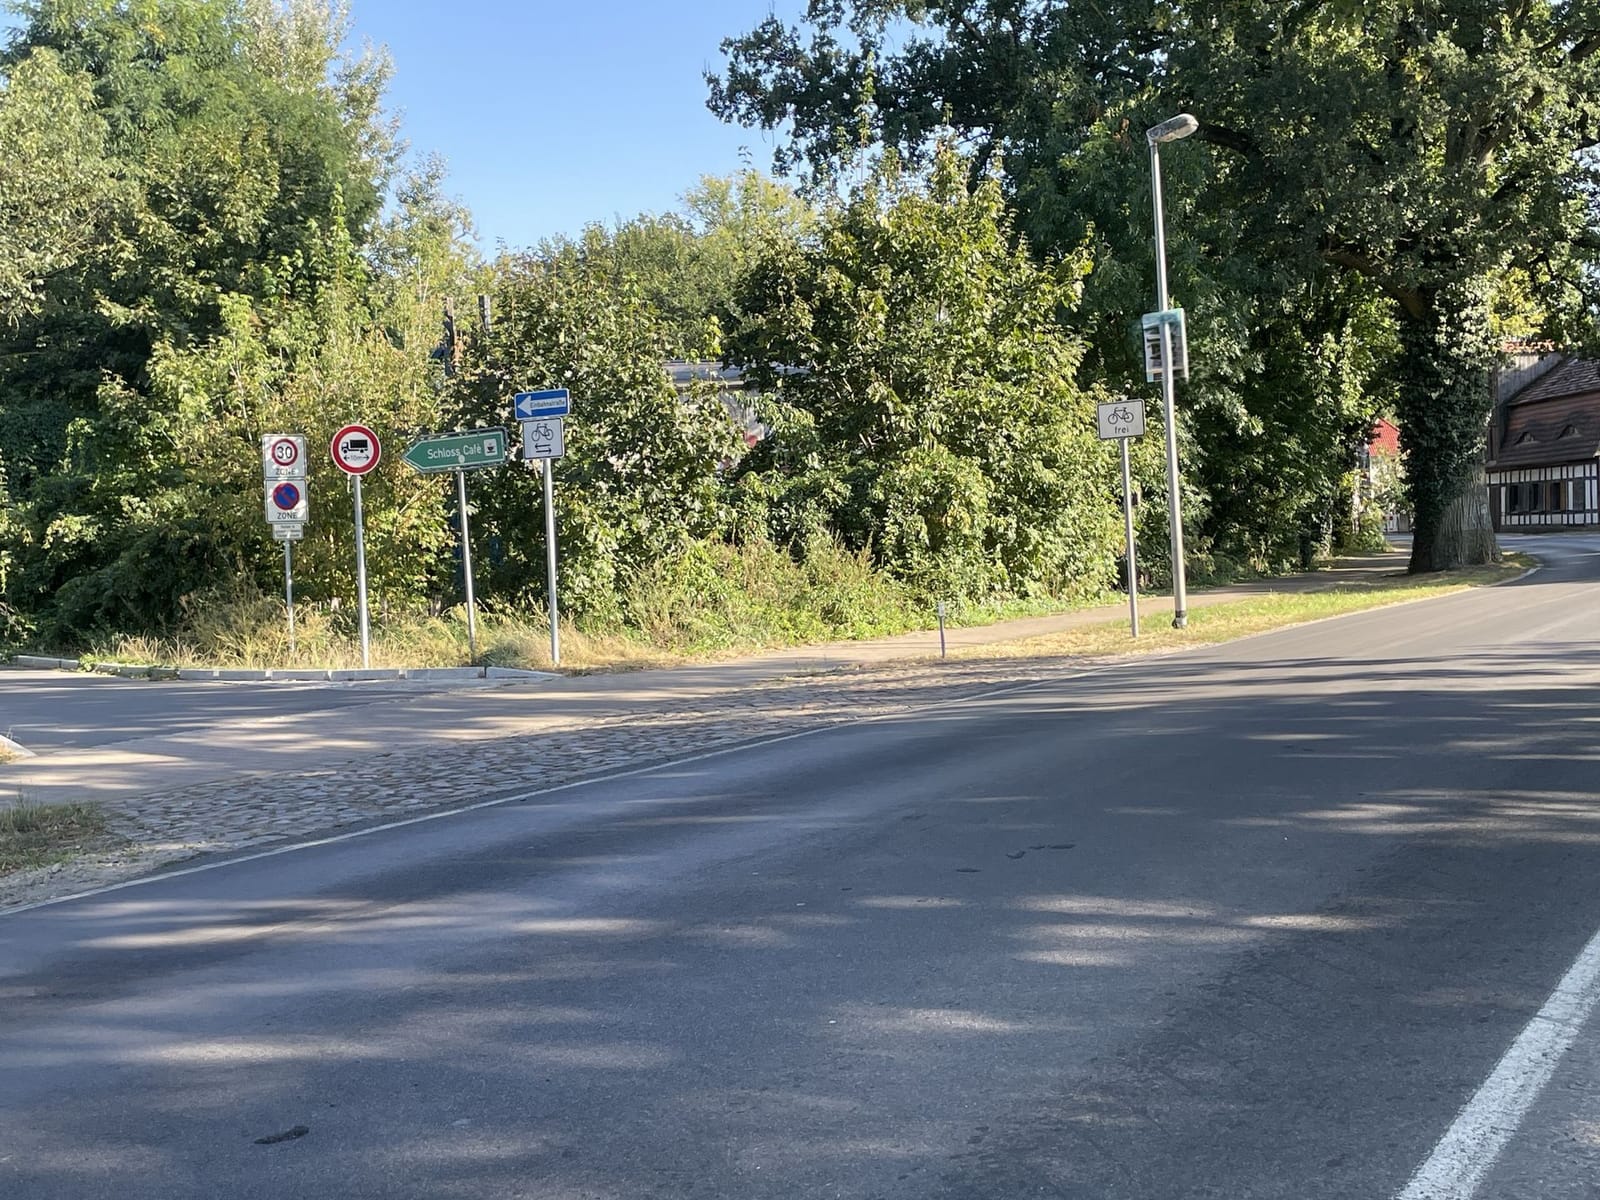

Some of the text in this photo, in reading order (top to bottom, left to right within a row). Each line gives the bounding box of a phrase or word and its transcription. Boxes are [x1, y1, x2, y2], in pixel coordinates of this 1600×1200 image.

[1114, 426, 1129, 434] frei
[277, 446, 293, 459] 30
[427, 447, 460, 459] Schloss
[275, 468, 296, 476] ZONE
